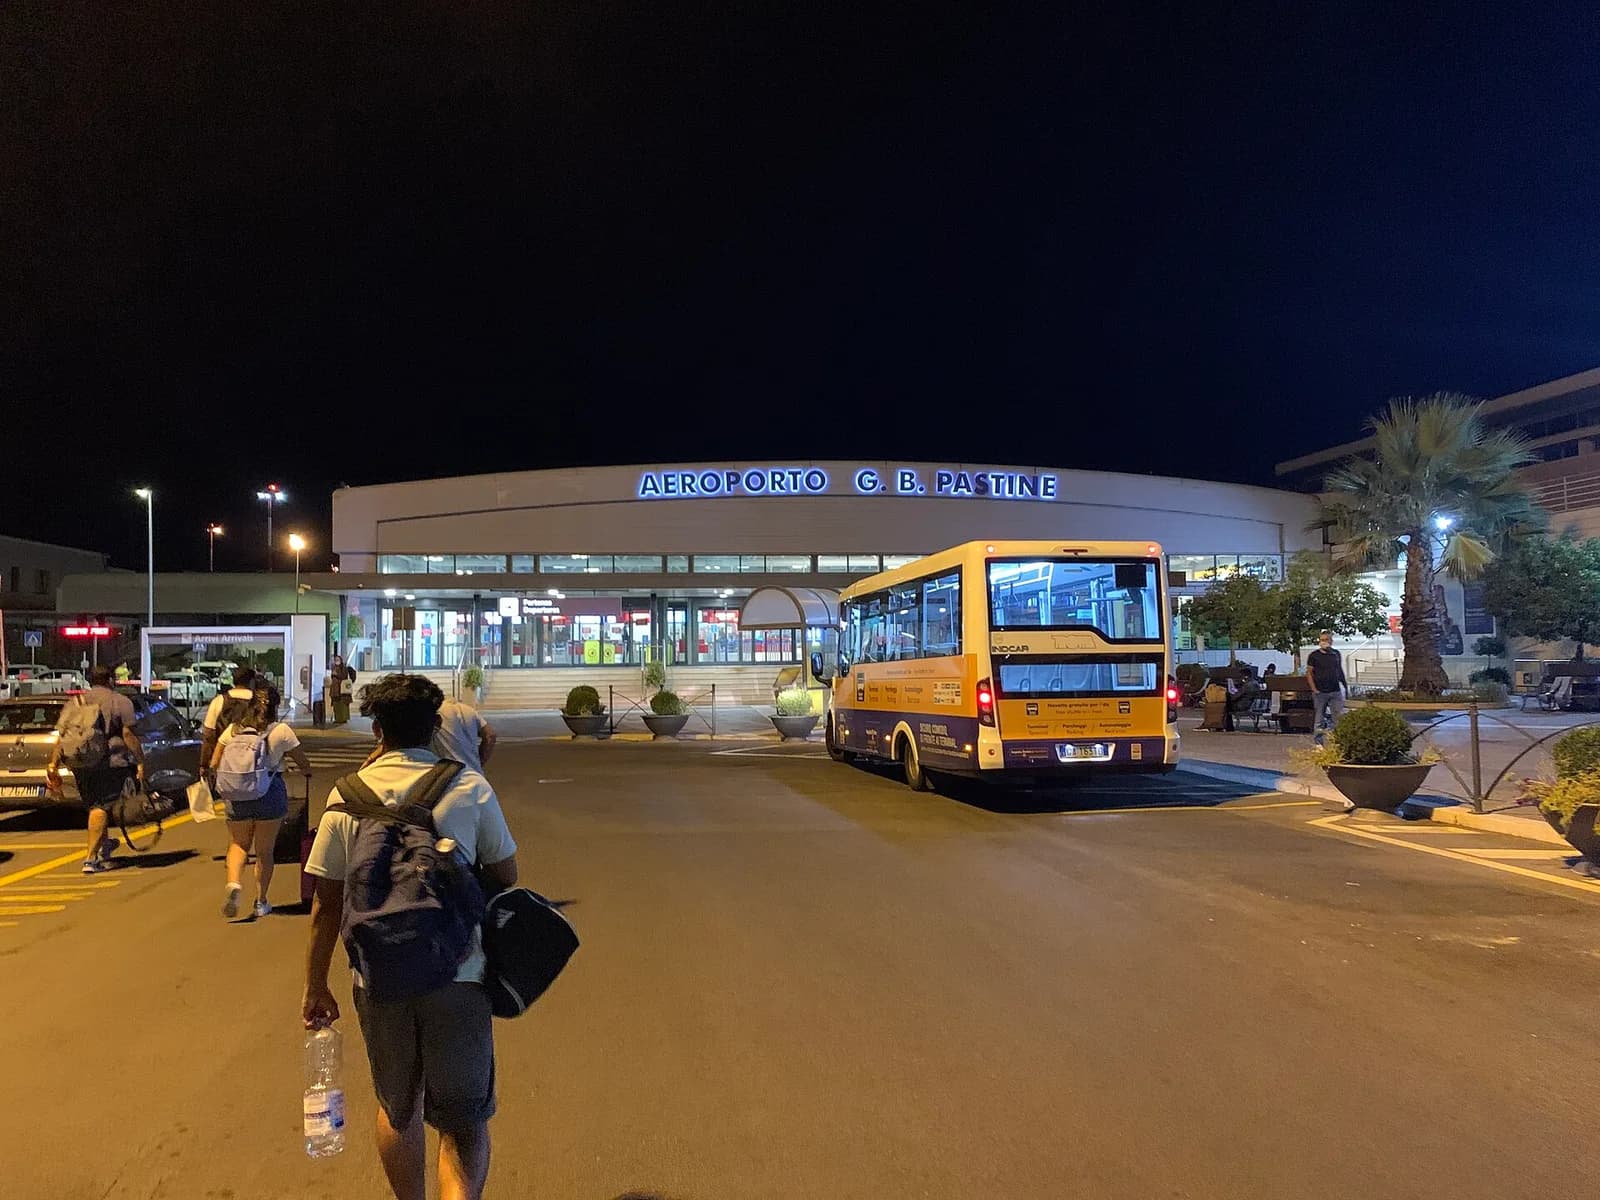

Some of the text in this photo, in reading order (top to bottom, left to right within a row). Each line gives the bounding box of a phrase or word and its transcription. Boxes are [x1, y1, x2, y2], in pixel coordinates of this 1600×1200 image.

[640, 470, 1056, 497] AEROPORTO G. B. PASTINE
[222, 634, 254, 642] Arrivals
